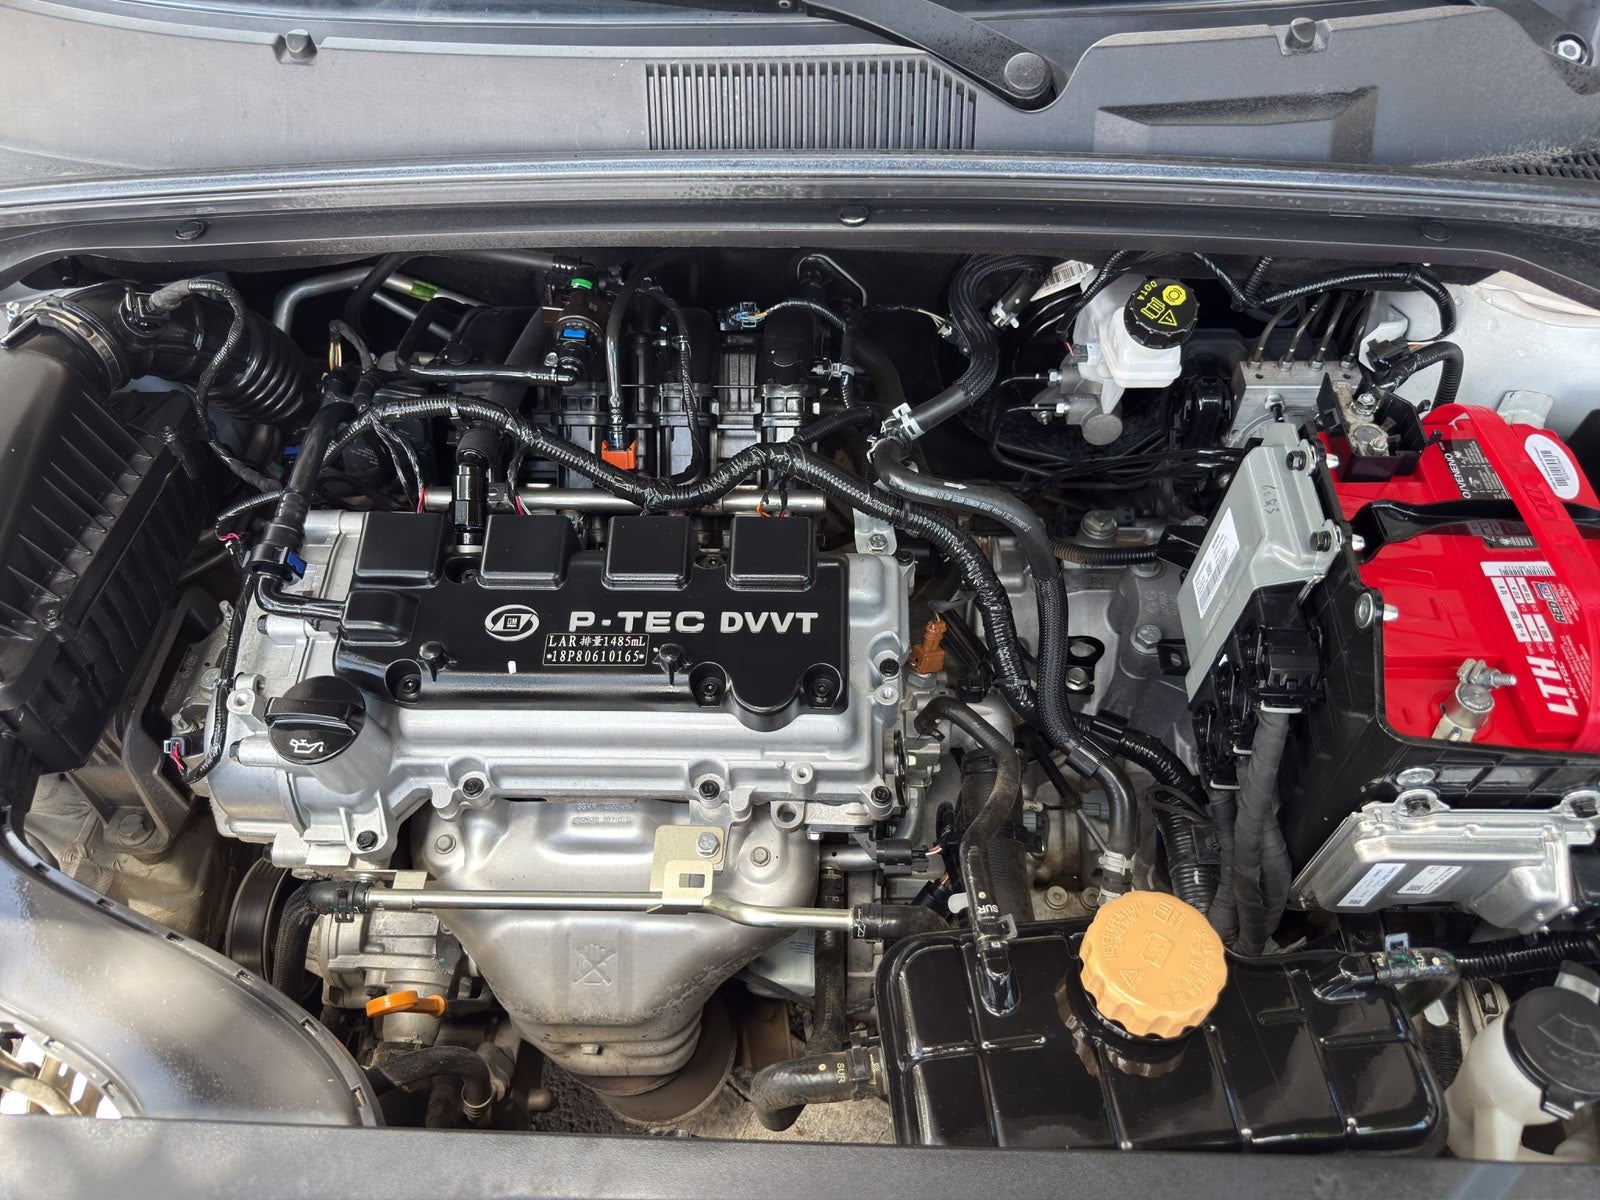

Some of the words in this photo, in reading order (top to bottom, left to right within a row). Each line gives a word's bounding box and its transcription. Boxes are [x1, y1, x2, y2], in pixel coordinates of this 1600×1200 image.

[720, 611, 819, 634] DVVT
[1549, 601, 1567, 623] RED
[548, 635, 577, 647] LAR
[1526, 656, 1579, 717] LTH
[836, 1062, 846, 1084] SUR
